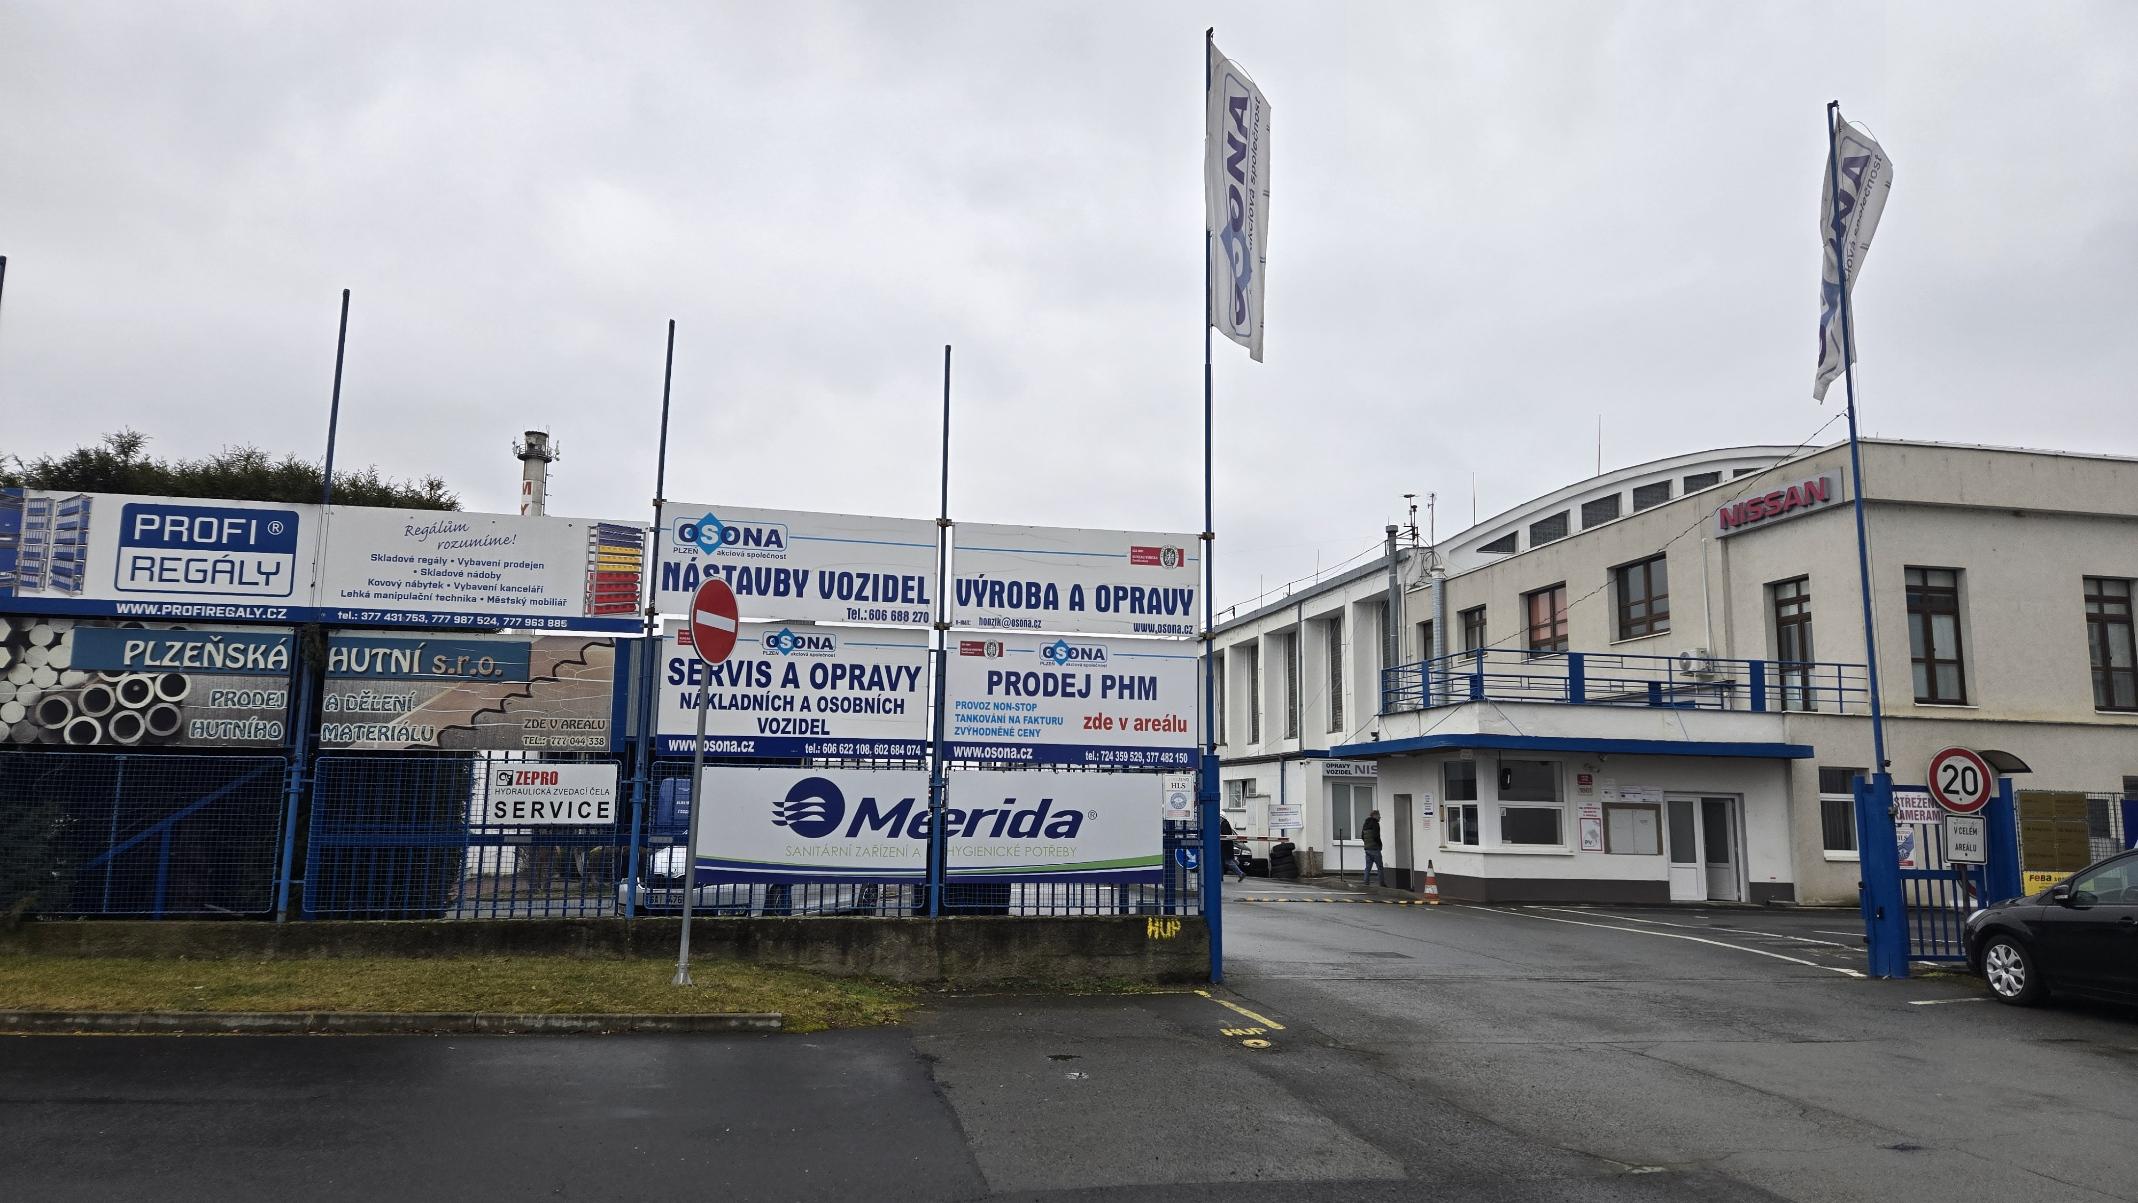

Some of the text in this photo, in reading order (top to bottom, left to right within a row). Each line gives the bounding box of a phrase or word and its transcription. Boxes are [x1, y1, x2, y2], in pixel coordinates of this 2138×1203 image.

[1719, 476, 1826, 530] NISSAN
[134, 513, 257, 545] PROFI
[404, 520, 470, 542] Regálům
[678, 522, 784, 549] OSONA
[437, 534, 517, 551] rozumíme!
[673, 545, 787, 561] PLZEŇ akciová společnost
[129, 554, 281, 587] REGÁLY
[370, 553, 545, 571] Skladové regály Vybavení prodejen
[420, 568, 502, 582] Skladové nádoby
[368, 578, 544, 594] Kovový nábytek Vybavení kanceláří
[818, 570, 931, 605] VOZIDEL
[956, 573, 1194, 616] VÝROBA A OPRAVY
[340, 589, 568, 607] Lehká manipulační technika Městský mobiliář
[116, 603, 287, 619] WWW.PROFIREGALY.CZ
[338, 611, 568, 628] tel.: 377 431 753, 777 987 524, 777 963 885
[868, 609, 887, 621] 606
[890, 610, 909, 622] 688
[911, 611, 930, 623] 270
[978, 616, 1042, 629] honzik@osona.cz
[1133, 622, 1193, 635] www.osona.cz
[765, 633, 834, 650] OSONA
[123, 635, 289, 670] PLZEŇSKÁ
[328, 642, 503, 677] HUTNÍ s.r.o.
[1042, 645, 1105, 661] OSONA
[667, 657, 922, 692] SERVIS A OPRAVY
[987, 670, 1157, 701] PRODEJ PHM
[209, 690, 286, 708] PRODEJ
[324, 690, 416, 713] A DĚLENÍ
[680, 689, 905, 714] NÁKLADNÍCH A OSOBNÍCH
[955, 700, 1037, 712] PROVOZ NON-STOP
[523, 718, 547, 729] ZDE
[560, 716, 606, 730] AREÁLU
[757, 717, 830, 735] VOZIDEL
[955, 712, 1064, 725] TANKOVÁNÍ NA FAKTURU
[1083, 713, 1188, 733] zde v areálu
[188, 716, 285, 740] HUTNÍHO
[322, 721, 435, 743] MATERIÁLU
[954, 726, 1041, 738] ZVÝHODNĚNÉ CENY
[523, 736, 605, 746] TEL.: 777 044 338
[668, 739, 755, 753] wwwosona.cz
[805, 743, 821, 755] tel.:
[822, 744, 837, 754] 606
[839, 745, 853, 755] 622
[874, 745, 888, 755] 602
[890, 745, 904, 755] 684
[906, 746, 921, 756] 074
[953, 746, 1033, 760] www.osona.cz
[1085, 751, 1188, 764] tel.: 724 359 529, 377 482 150
[515, 770, 559, 786] ZEPRO
[1942, 764, 1979, 797] 20
[494, 786, 610, 796] HYDRAULICKÁ ZVEDACÍ ČELA
[494, 801, 610, 819] SERVICE
[1953, 825, 1978, 836] V CELÉM
[785, 844, 922, 858] SANITÁRNÍ ZAŘÍZENÍ A
[948, 843, 1078, 857] HYGIENICKÉ POTŘEBY
[1954, 842, 1977, 852] AREÁLU
[1146, 916, 1182, 939] HUP
